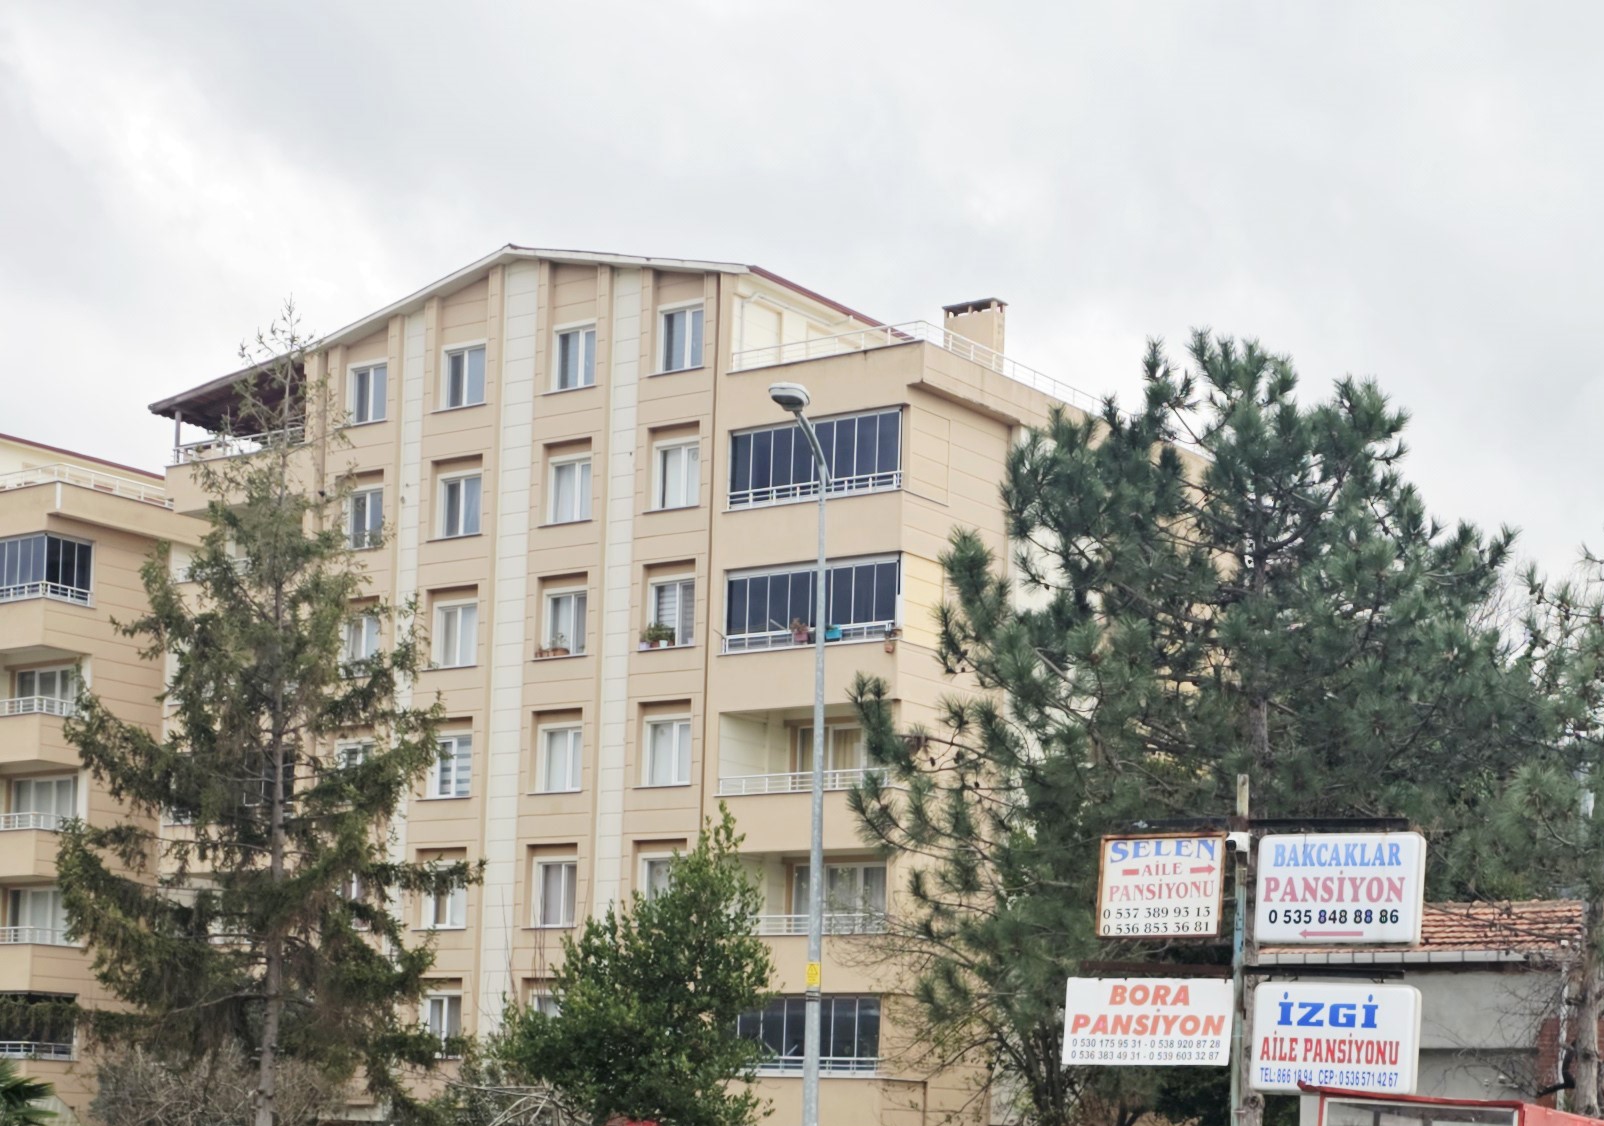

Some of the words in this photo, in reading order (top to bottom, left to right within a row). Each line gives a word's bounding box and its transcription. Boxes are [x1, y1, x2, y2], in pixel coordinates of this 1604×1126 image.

[1110, 839, 1217, 863] SELEN
[1273, 843, 1401, 867] BAKCAKLAR
[1142, 860, 1183, 876] AİLE
[1108, 878, 1214, 902] PANSİYONU
[1263, 870, 1406, 903] PANSİYON
[1103, 909, 1111, 920] 0
[1115, 908, 1140, 919] 537
[1144, 907, 1169, 919] 389
[1173, 907, 1190, 918] 93
[1195, 906, 1211, 917] 13
[1268, 909, 1278, 924] 0
[1283, 909, 1312, 924] 535
[1318, 909, 1348, 924] 848
[1353, 909, 1373, 924] 88
[1379, 909, 1399, 924] 86
[1103, 924, 1111, 935] 0
[1115, 923, 1140, 934] 536
[1144, 923, 1168, 934] 853
[1173, 922, 1189, 933] 36
[1194, 921, 1209, 932] 81
[1108, 984, 1190, 1006] BORA
[1277, 991, 1379, 1029] İZGİ
[1070, 1008, 1226, 1037] PANSİYON
[1072, 1038, 1078, 1047] 0
[1080, 1038, 1096, 1047] 530
[1100, 1039, 1115, 1048] 175
[1117, 1039, 1128, 1048] 95
[1131, 1040, 1141, 1048] 31
[1150, 1040, 1155, 1049] 0
[1158, 1040, 1175, 1049] 538
[1177, 1040, 1194, 1049] 920
[1196, 1040, 1207, 1049] 87
[1210, 1040, 1221, 1049] 28
[1259, 1030, 1298, 1062] AİLE
[1302, 1033, 1400, 1065] PANSİYONU
[1071, 1050, 1077, 1059] 0
[1079, 1050, 1095, 1060] 536
[1098, 1051, 1114, 1060] 383
[1117, 1051, 1128, 1060] 49
[1130, 1051, 1140, 1060] 31
[1149, 1051, 1155, 1060] 0
[1157, 1051, 1173, 1060] 539
[1176, 1051, 1192, 1060] 603
[1195, 1051, 1206, 1060] 32
[1208, 1051, 1219, 1060] 87
[1277, 1069, 1291, 1083] 866
[1339, 1070, 1344, 1085] 0
[1345, 1071, 1359, 1085] 536
[1361, 1071, 1375, 1086] 571
[1377, 1072, 1387, 1086] 42
[1389, 1072, 1399, 1087] 67
